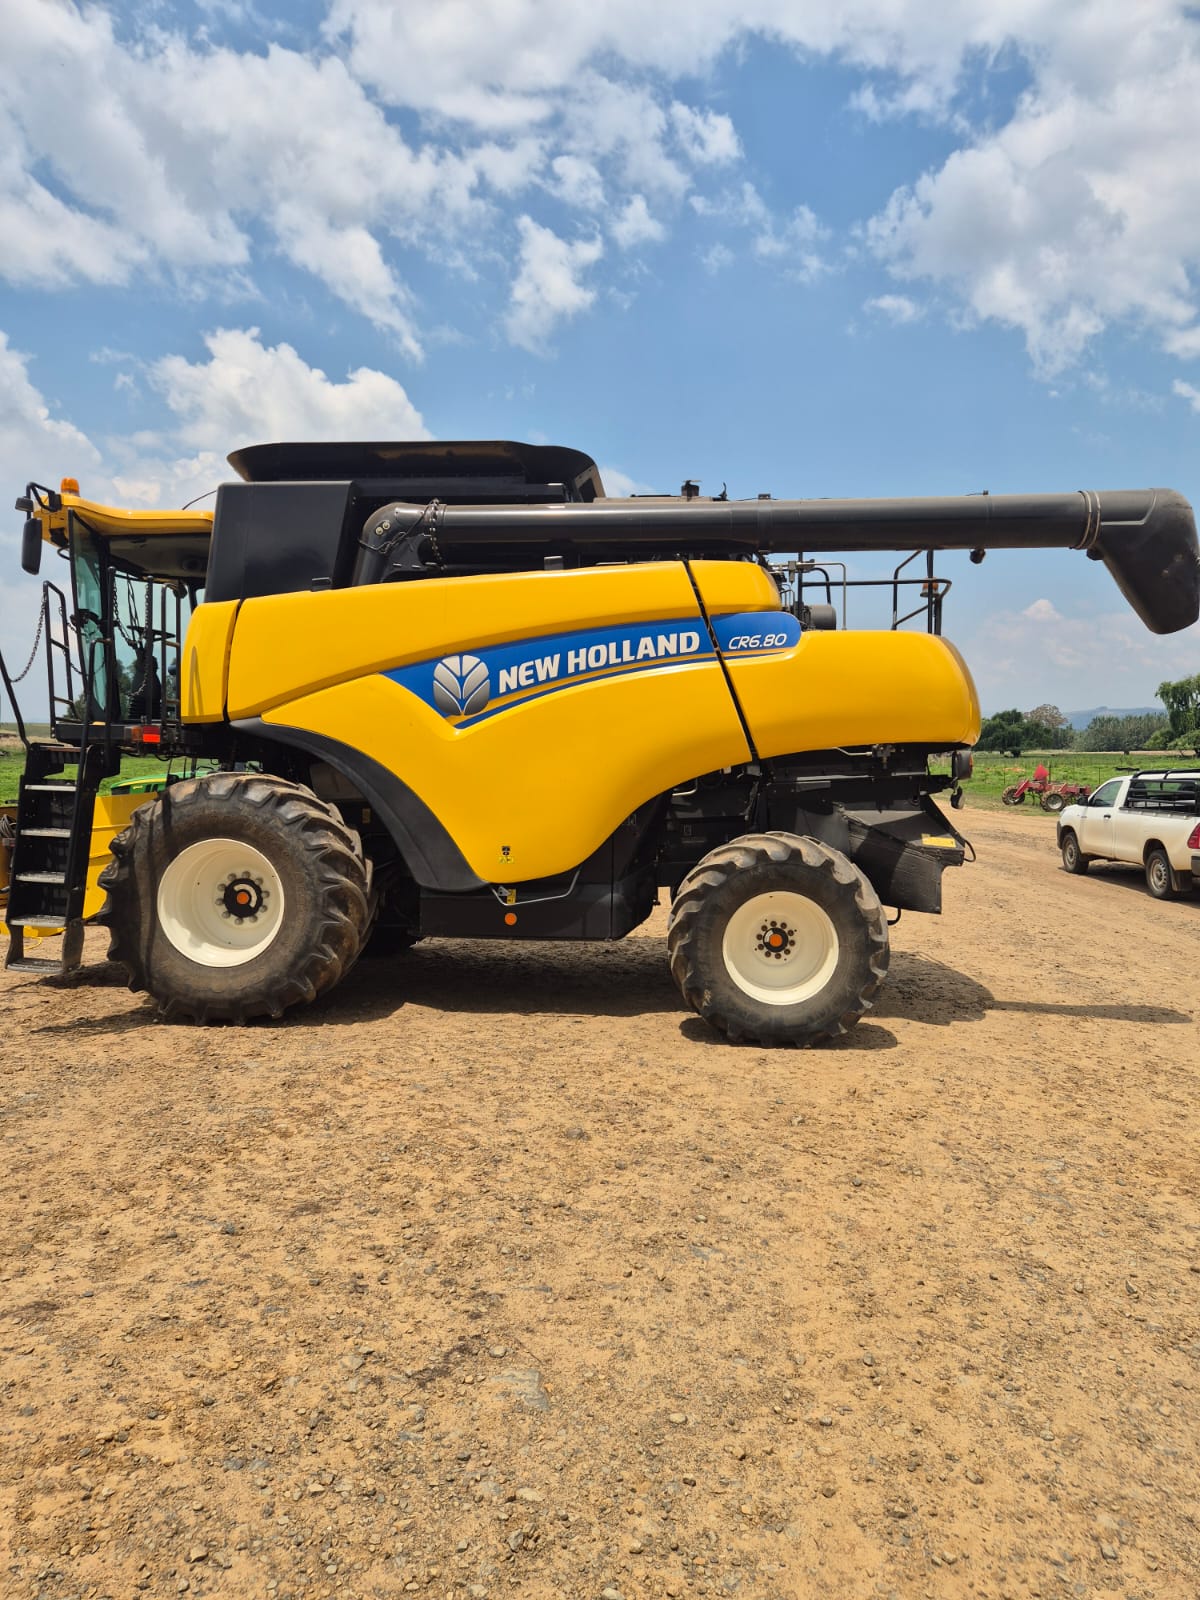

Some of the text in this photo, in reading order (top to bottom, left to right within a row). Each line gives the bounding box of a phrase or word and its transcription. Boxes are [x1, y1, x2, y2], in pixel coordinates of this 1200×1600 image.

[728, 633, 787, 650] CR6.80
[499, 631, 700, 694] NEW HOLLAND
